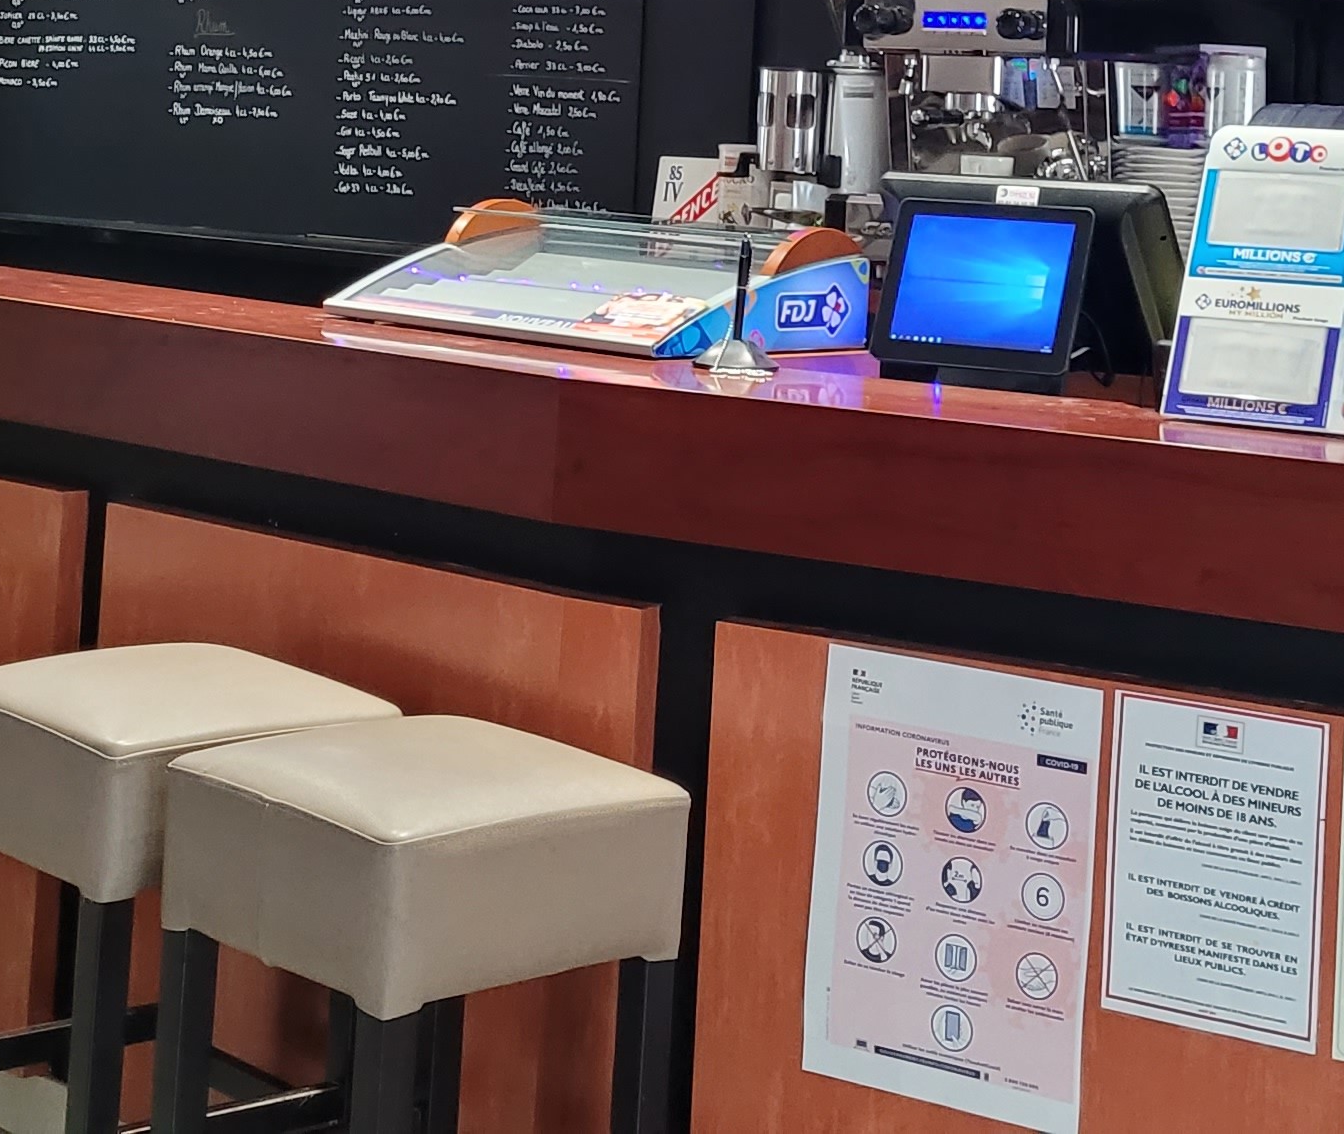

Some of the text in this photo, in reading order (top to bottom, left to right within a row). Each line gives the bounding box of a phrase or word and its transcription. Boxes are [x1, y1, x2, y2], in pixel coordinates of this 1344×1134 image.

[1251, 136, 1328, 163] LOTO
[669, 166, 683, 180] 85
[663, 182, 683, 202] IV
[1233, 248, 1302, 262] MILLIONS
[779, 300, 817, 326] FDJ
[1215, 298, 1301, 314] EUROMILLIONS
[1207, 396, 1277, 413] MILLIONS
[1039, 717, 1073, 730] publique
[1040, 707, 1063, 718] Santé
[856, 723, 950, 746] INFORMATION CORONAVIRUS
[1039, 727, 1061, 737] France
[917, 747, 1019, 774] PROTÉGEONS-NOUS
[915, 758, 1020, 786] LES UNS LES AUTRES
[1139, 764, 1299, 801] IL EST INTERDIT DE VENDRE
[1135, 778, 1302, 816] DE L'ALCOOL À DES MINEURS
[1157, 797, 1277, 828] DE MOINS DE 18 ANS.
[1037, 887, 1049, 907] 6
[1128, 873, 1300, 913] IL EST INTERDIT DE VENDRE À CRÉDIT
[1147, 887, 1164, 897] DES
[1167, 891, 1212, 907] BOISSONS
[1125, 932, 1298, 975] ÉTAT D'IVRESSE MANIFESTE DANS LES
[1126, 922, 1298, 964] IL EST INTERDIT DE SE TROUVER EN
[1174, 954, 1246, 976] LIEUX PUBLICS.
